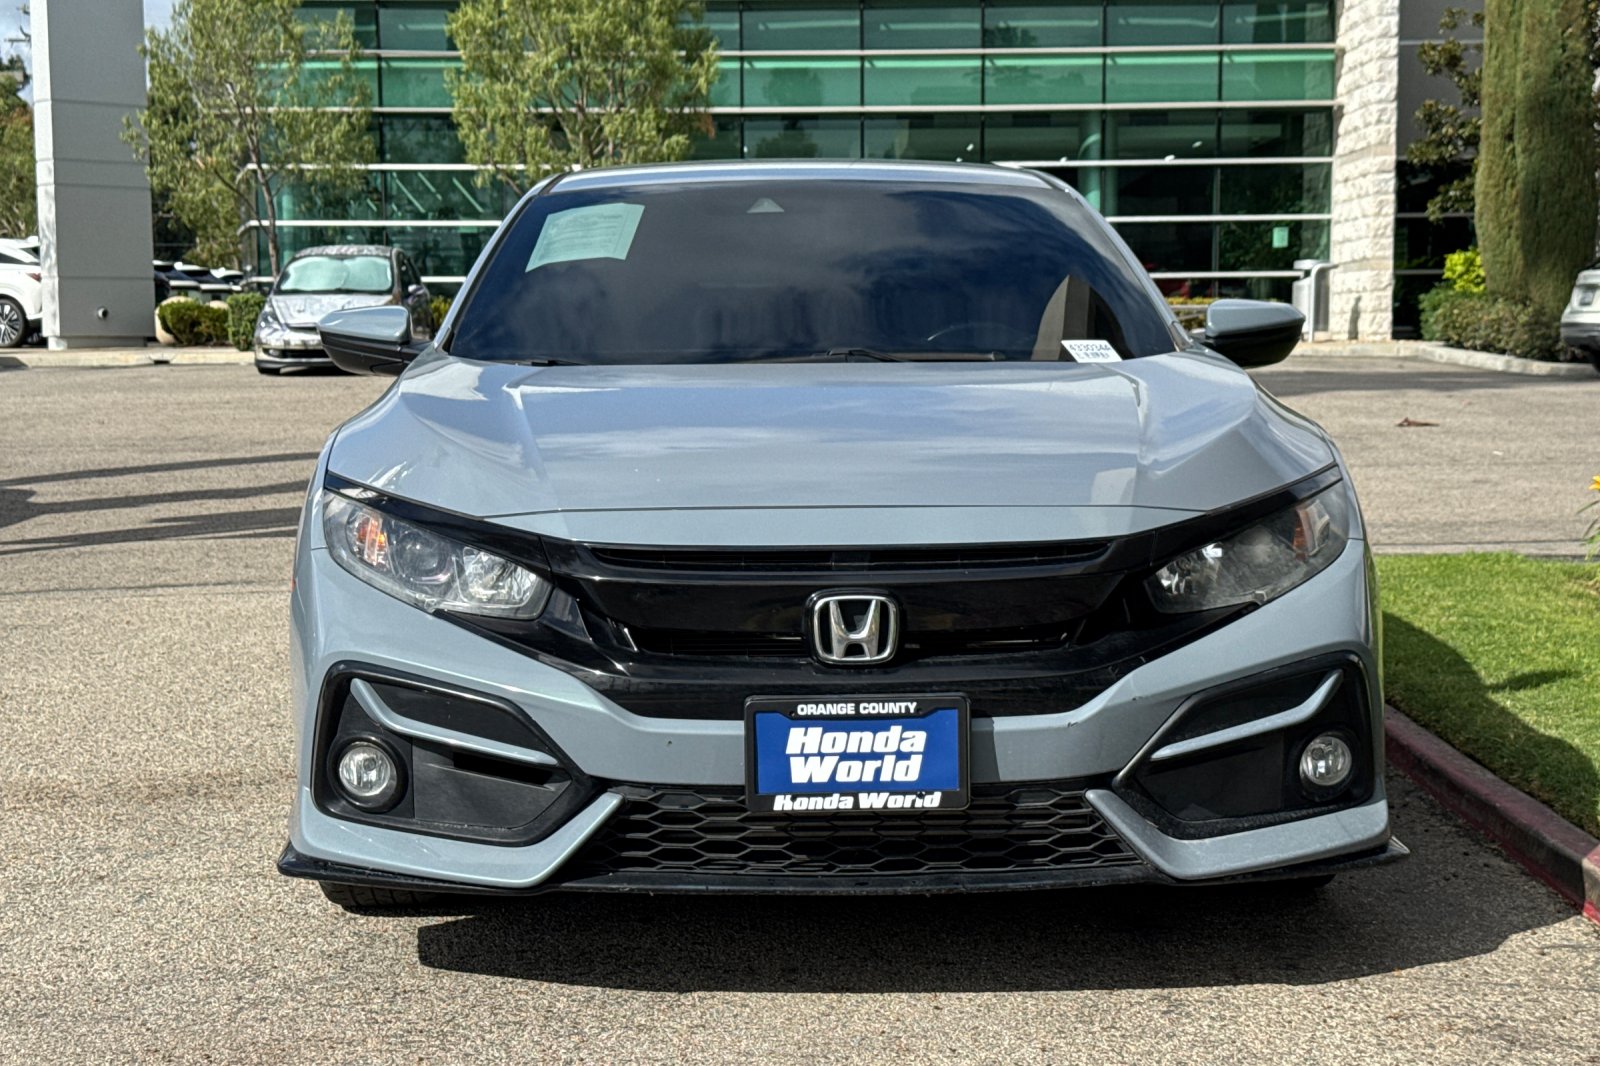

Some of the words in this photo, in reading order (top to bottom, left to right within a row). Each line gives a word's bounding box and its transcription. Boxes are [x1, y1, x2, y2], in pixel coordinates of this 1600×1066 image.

[797, 703, 855, 716] ORANGE
[859, 702, 917, 715] COUNTY
[785, 725, 927, 755] Honda
[789, 754, 923, 784] World
